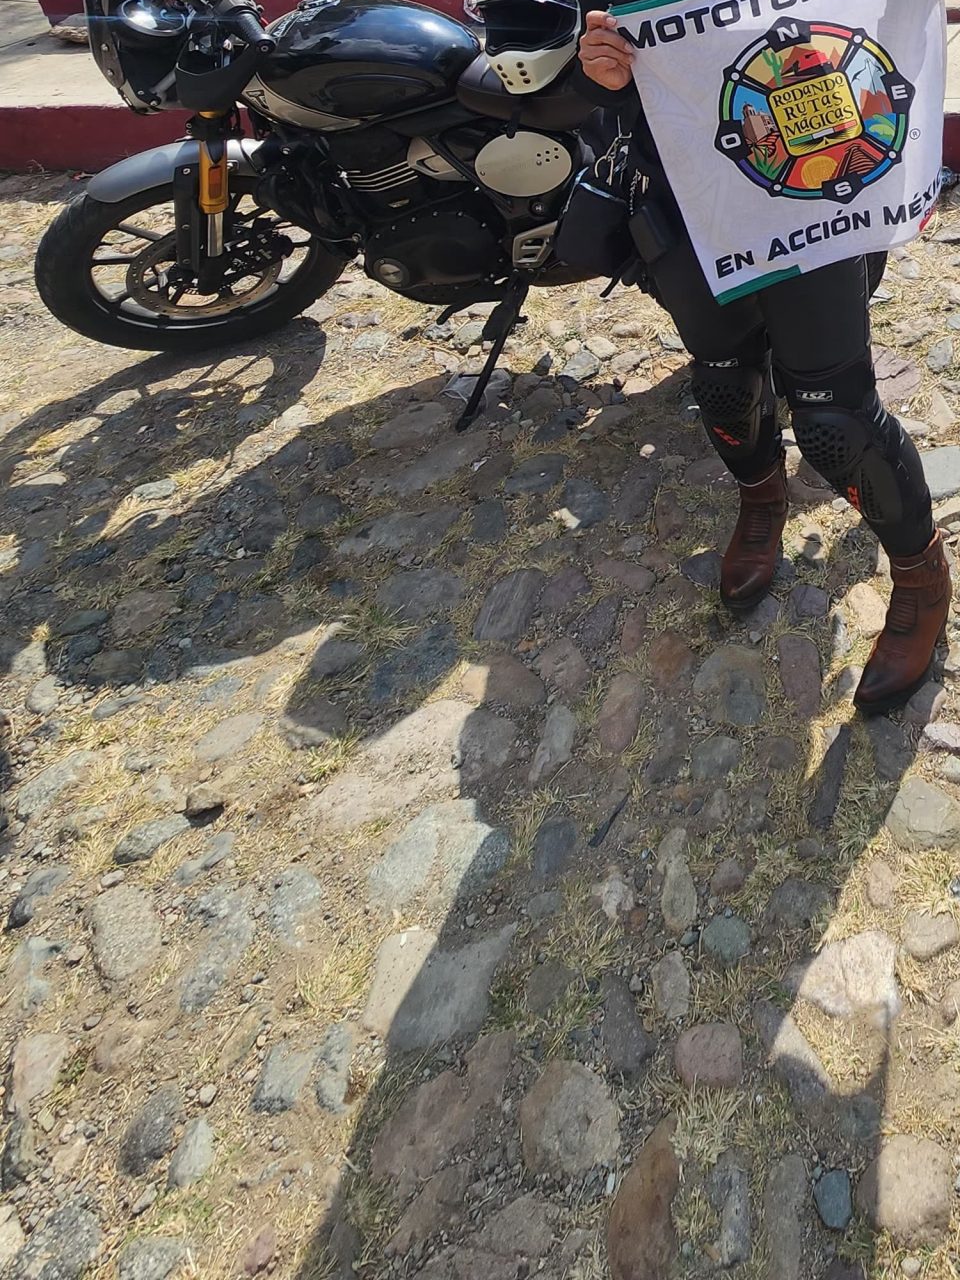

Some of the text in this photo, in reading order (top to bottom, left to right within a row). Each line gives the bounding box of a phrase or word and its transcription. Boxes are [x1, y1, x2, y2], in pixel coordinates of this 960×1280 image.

[776, 23, 800, 42] N
[891, 84, 908, 100] E
[834, 181, 852, 197] S
[715, 250, 755, 279] EN
[766, 209, 871, 261] ACCIÓN
